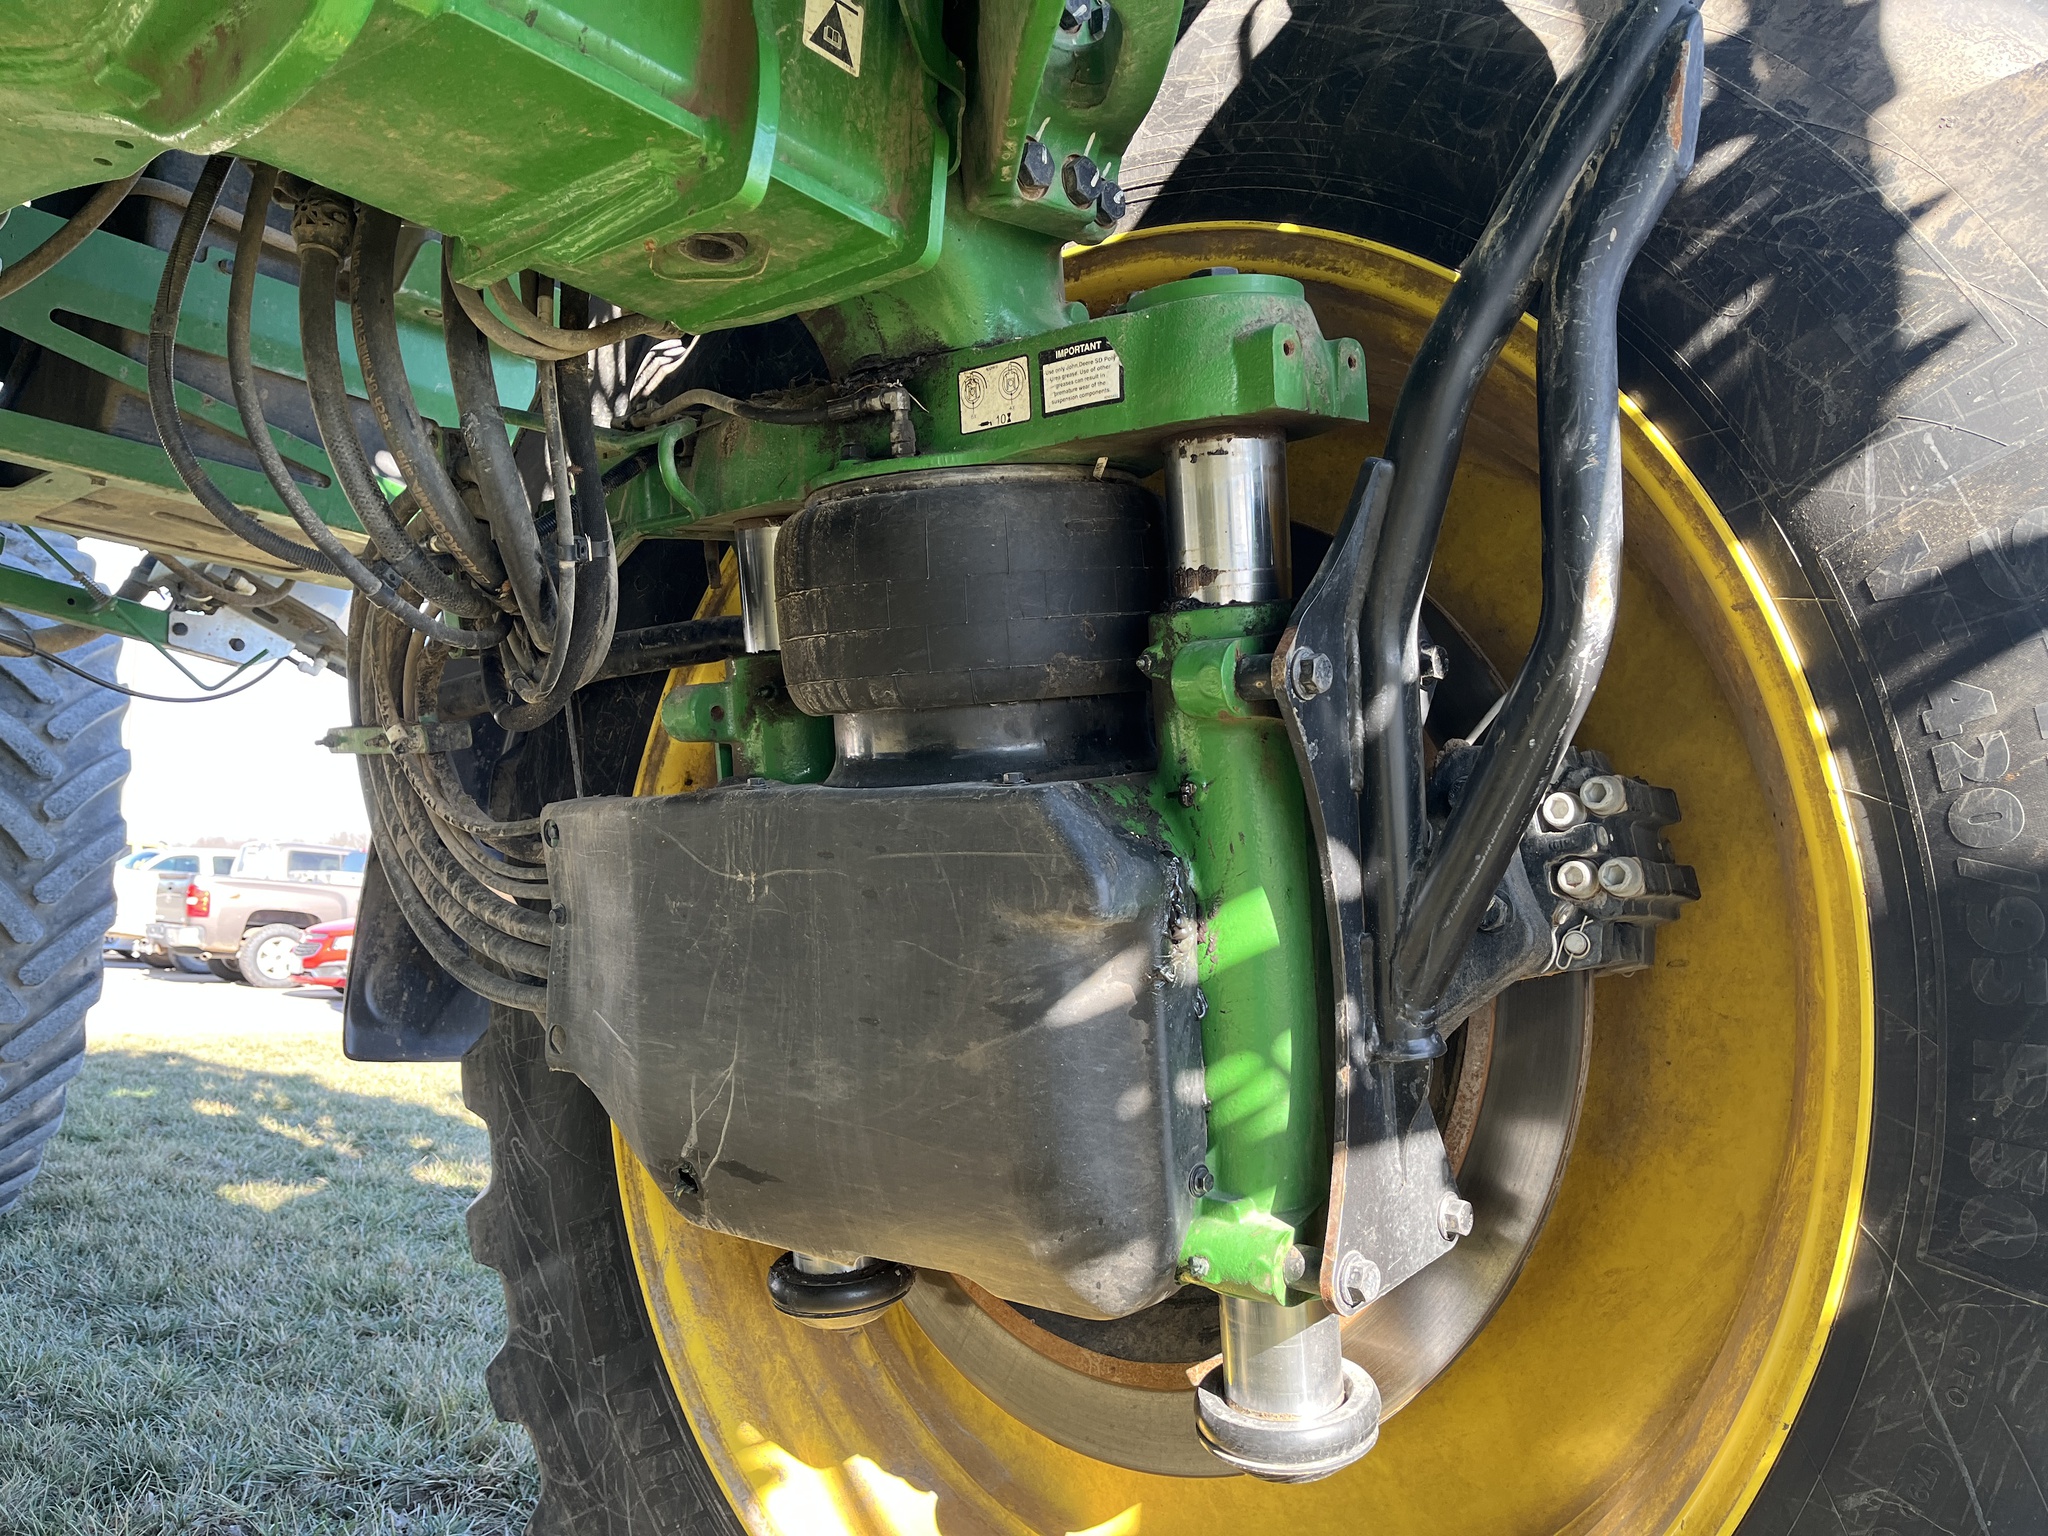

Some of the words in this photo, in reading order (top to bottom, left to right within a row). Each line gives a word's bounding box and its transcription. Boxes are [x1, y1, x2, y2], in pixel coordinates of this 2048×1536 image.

[1055, 340, 1102, 359] IMPORTANT
[1055, 366, 1065, 374] only
[1104, 354, 1116, 363] Poly
[1051, 395, 1079, 405] suspension
[1053, 388, 1078, 397] premature
[371, 396, 392, 431] tech
[996, 413, 1006, 424] 10
[407, 476, 482, 579] ALFAGOMMA
[1864, 530, 1969, 654] VF
